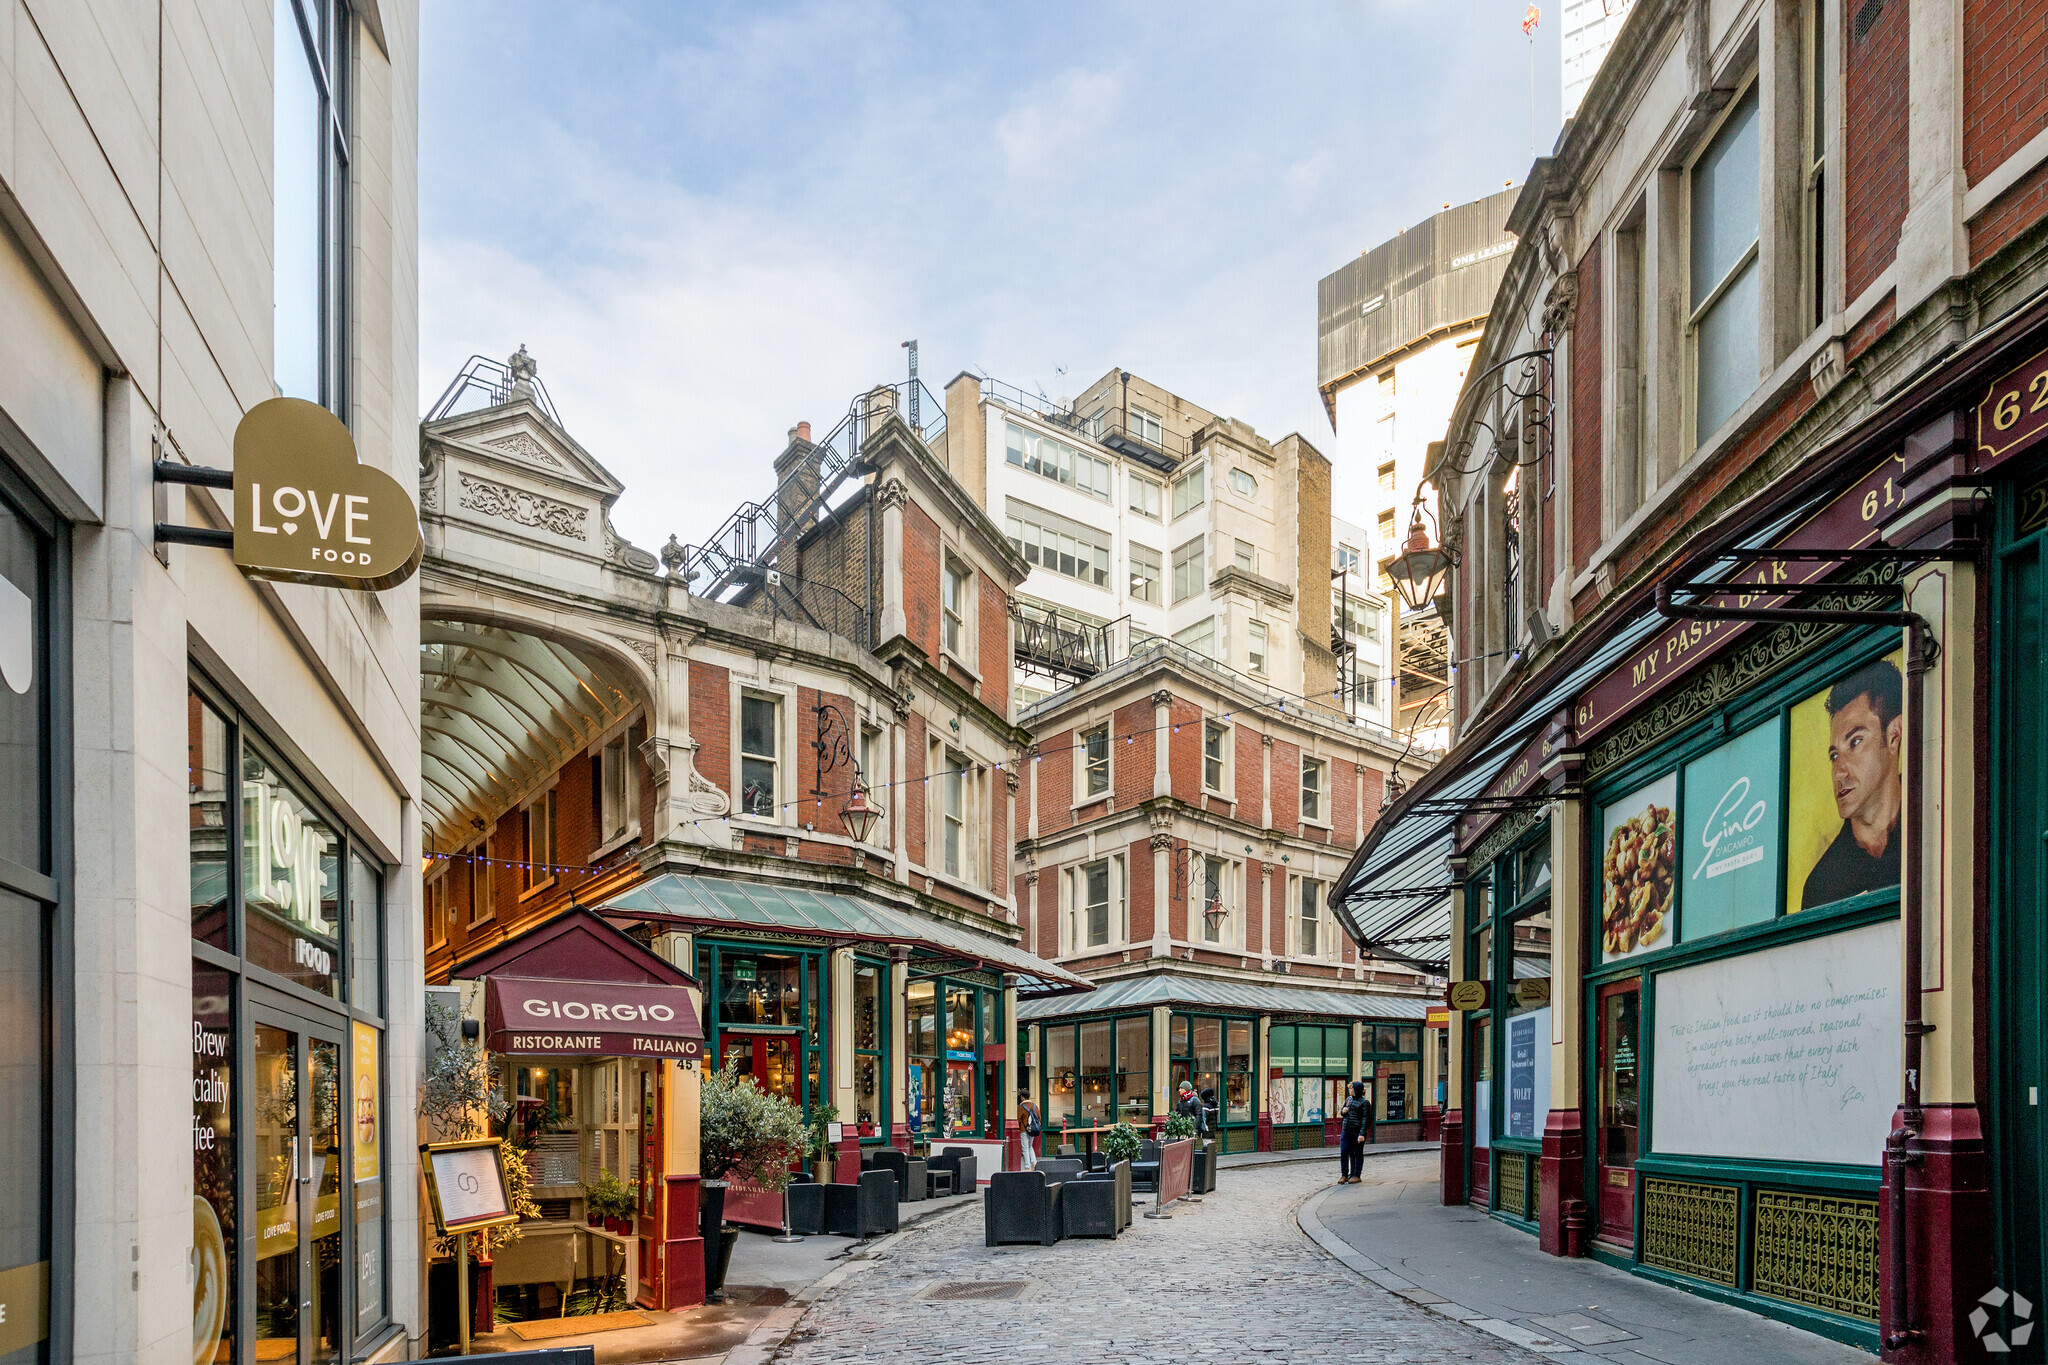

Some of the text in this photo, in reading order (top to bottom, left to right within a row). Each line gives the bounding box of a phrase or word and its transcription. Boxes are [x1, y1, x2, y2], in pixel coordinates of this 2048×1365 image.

[1452, 253, 1476, 267] ONE
[1992, 369, 2048, 431] 62
[252, 482, 372, 545] LOVE
[1861, 476, 1895, 522] 61
[312, 547, 372, 565] FOOD
[1632, 648, 1660, 689] MY
[1579, 700, 1595, 726] 61
[1692, 776, 1766, 880] Gino
[258, 782, 331, 936] LOVE
[1715, 834, 1754, 858] D'ACAMPO
[1724, 857, 1741, 869] PASTA
[295, 938, 331, 976] FOOD
[724, 979, 793, 993] ROCCA
[522, 999, 675, 1023] GIORGIO
[1694, 1018, 1720, 1033] Italian
[1721, 1012, 1740, 1034] food
[1742, 1013, 1751, 1023] as
[1754, 1008, 1761, 1021] it
[1764, 1001, 1792, 1020] should
[1811, 1000, 1822, 1011] no
[1825, 987, 1889, 1010] compromises.
[194, 1020, 226, 1057] Brew
[513, 1036, 697, 1054] RISTORANTE ITALIANO
[1699, 1040, 1718, 1056] using
[1720, 1034, 1733, 1048] the
[1819, 1012, 1862, 1033] seasonal
[676, 1058, 693, 1070] 45
[1687, 1037, 1859, 1078] ingredients to make sure that every dish
[1697, 1079, 1719, 1096] brings
[1718, 1080, 1735, 1097] you
[1738, 1074, 1751, 1087] the
[1753, 1071, 1771, 1086] real
[1773, 1069, 1796, 1085] taste
[1798, 1063, 1809, 1088] of
[727, 1184, 767, 1194] LEADENHAL
[263, 1221, 291, 1240] LOVE FOOD
[315, 1208, 335, 1223] LOVE FOOD
